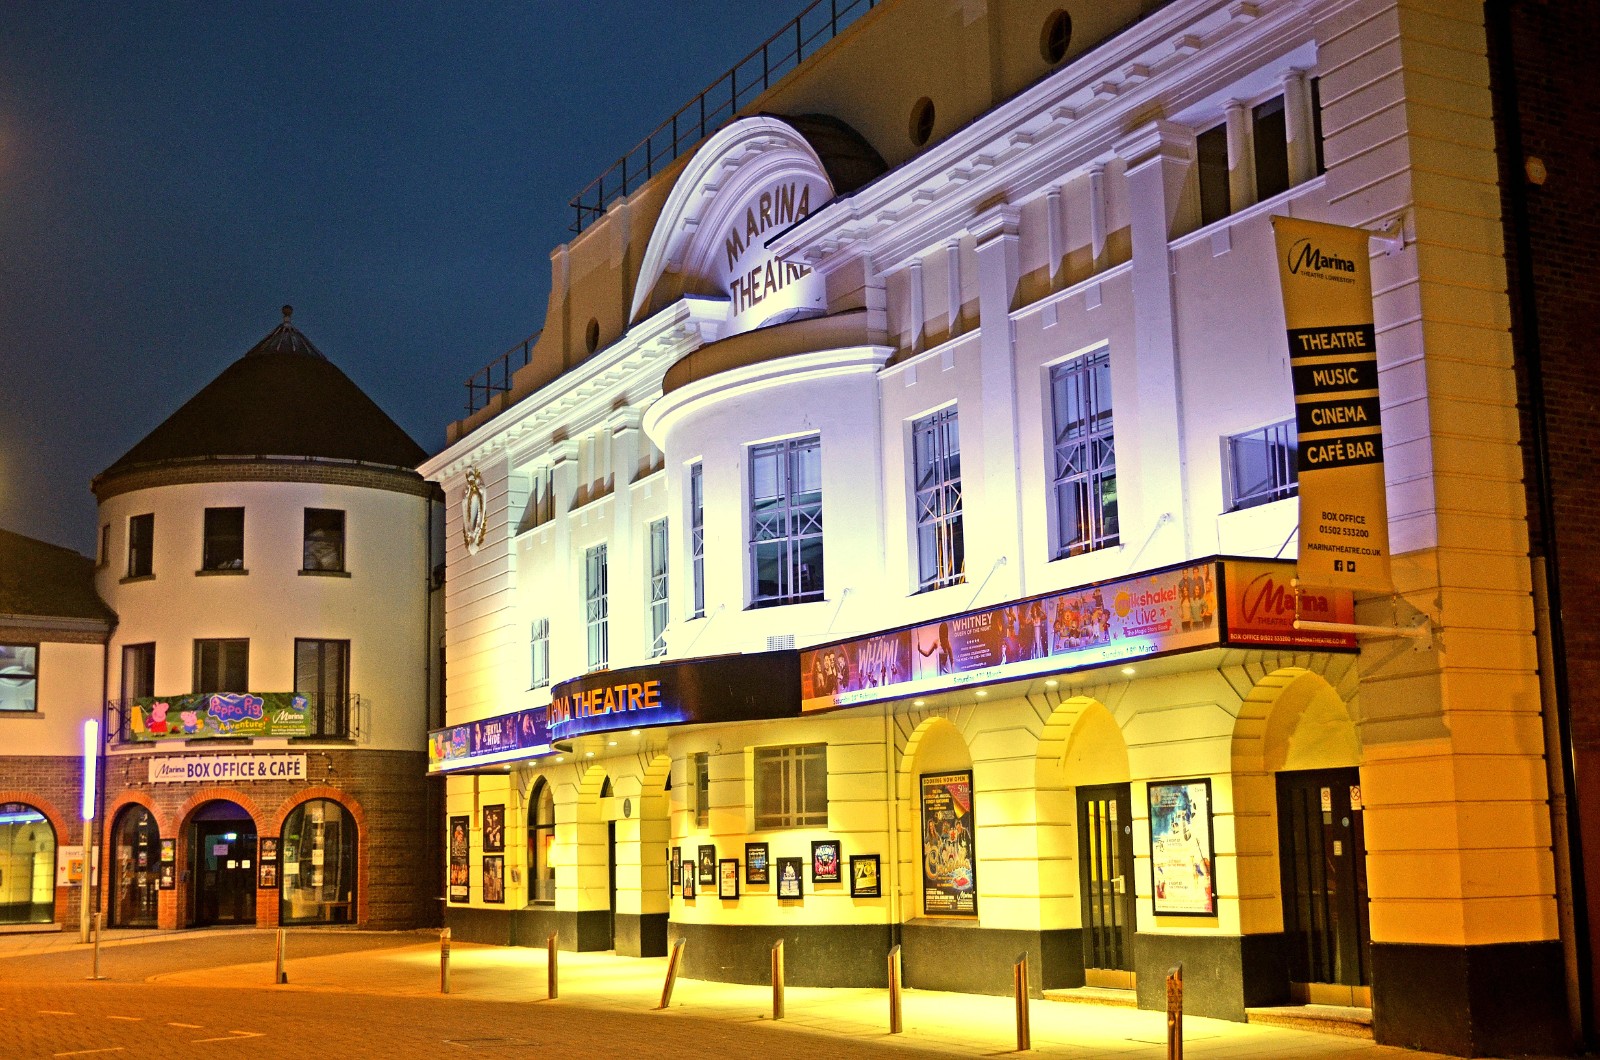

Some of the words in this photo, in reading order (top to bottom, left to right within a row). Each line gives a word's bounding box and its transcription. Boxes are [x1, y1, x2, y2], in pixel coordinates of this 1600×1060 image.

[725, 182, 810, 273] MARINA
[1288, 238, 1355, 275] Marina
[1301, 270, 1325, 280] THEATRE
[1326, 274, 1356, 285] LOWESTOFT
[1298, 331, 1366, 351] THEATRE
[1313, 367, 1359, 387] MUSIC
[1311, 405, 1367, 425] CINEMA
[1307, 439, 1346, 463] CAFÉ
[1346, 441, 1376, 459] BAR
[1322, 511, 1338, 522] BOX
[1339, 514, 1366, 525] OFFICE
[1319, 525, 1341, 535] 01502
[1342, 527, 1369, 538] 533200
[1307, 543, 1381, 557] MARINATHEATRE.CO.UK
[1242, 572, 1329, 624] Maina
[952, 612, 993, 631] WHITNEY
[1138, 643, 1158, 653] March
[211, 697, 242, 718] Peppa
[244, 697, 262, 717] Pig
[573, 680, 660, 718] THEATRE
[220, 719, 265, 731] Adventure!
[273, 710, 304, 724] Marina
[155, 763, 185, 778] Marina
[187, 763, 210, 778] BOX
[213, 761, 254, 777] OFFICE
[257, 761, 267, 776] &
[269, 758, 301, 776] CAFÉ
